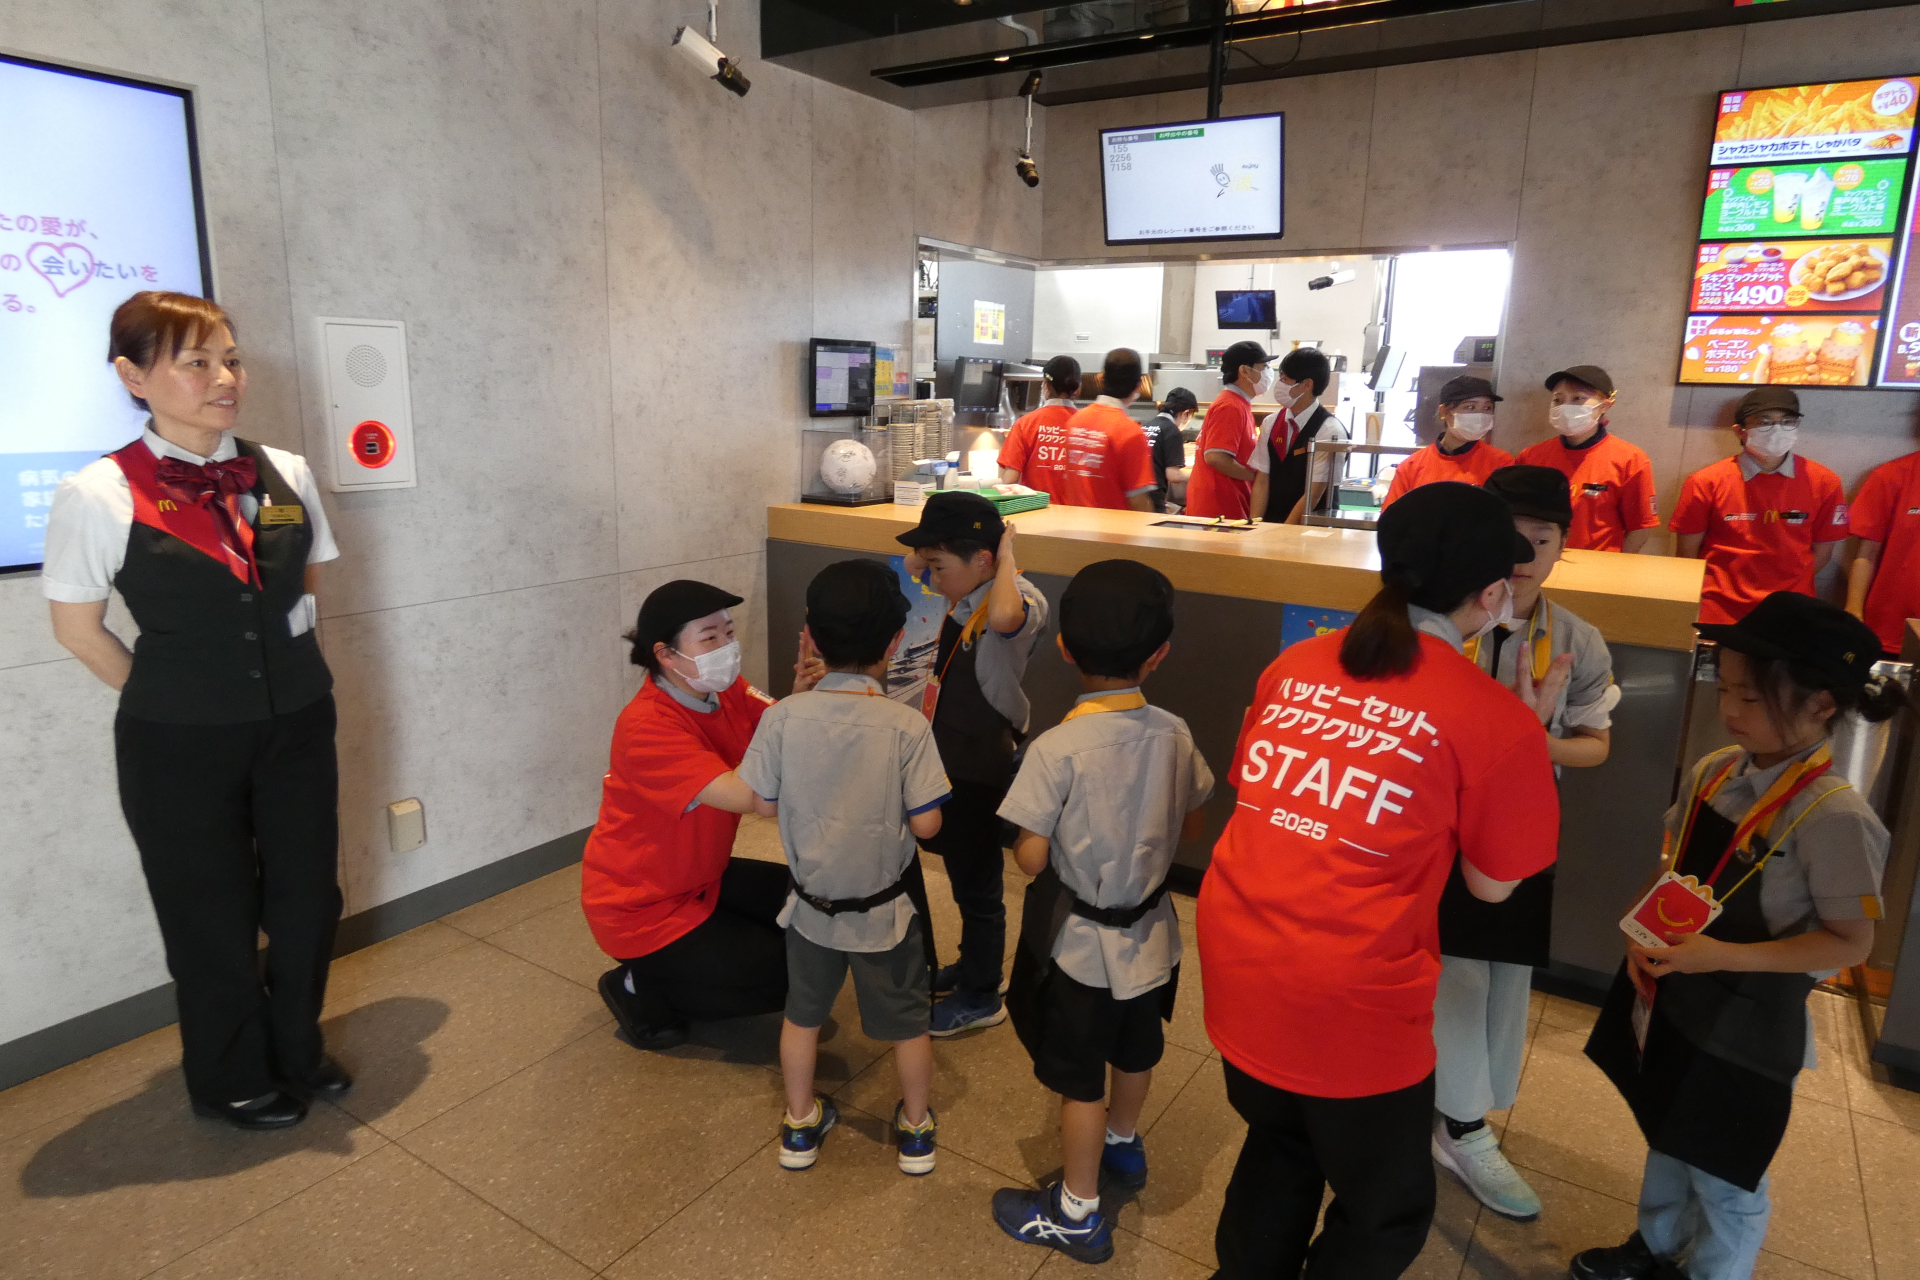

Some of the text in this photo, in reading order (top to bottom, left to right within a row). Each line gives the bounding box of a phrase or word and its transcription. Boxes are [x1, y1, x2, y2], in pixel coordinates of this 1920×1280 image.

[1113, 144, 1129, 153] 155
[1110, 153, 1132, 163] 2256
[1111, 162, 1132, 172] 7158
[1722, 284, 1784, 305] ¥490
[1706, 339, 1749, 349] ベーコン
[1704, 349, 1758, 360] ポテトパイ
[1241, 739, 1414, 826] STAFF
[1269, 807, 1329, 841] 2025
